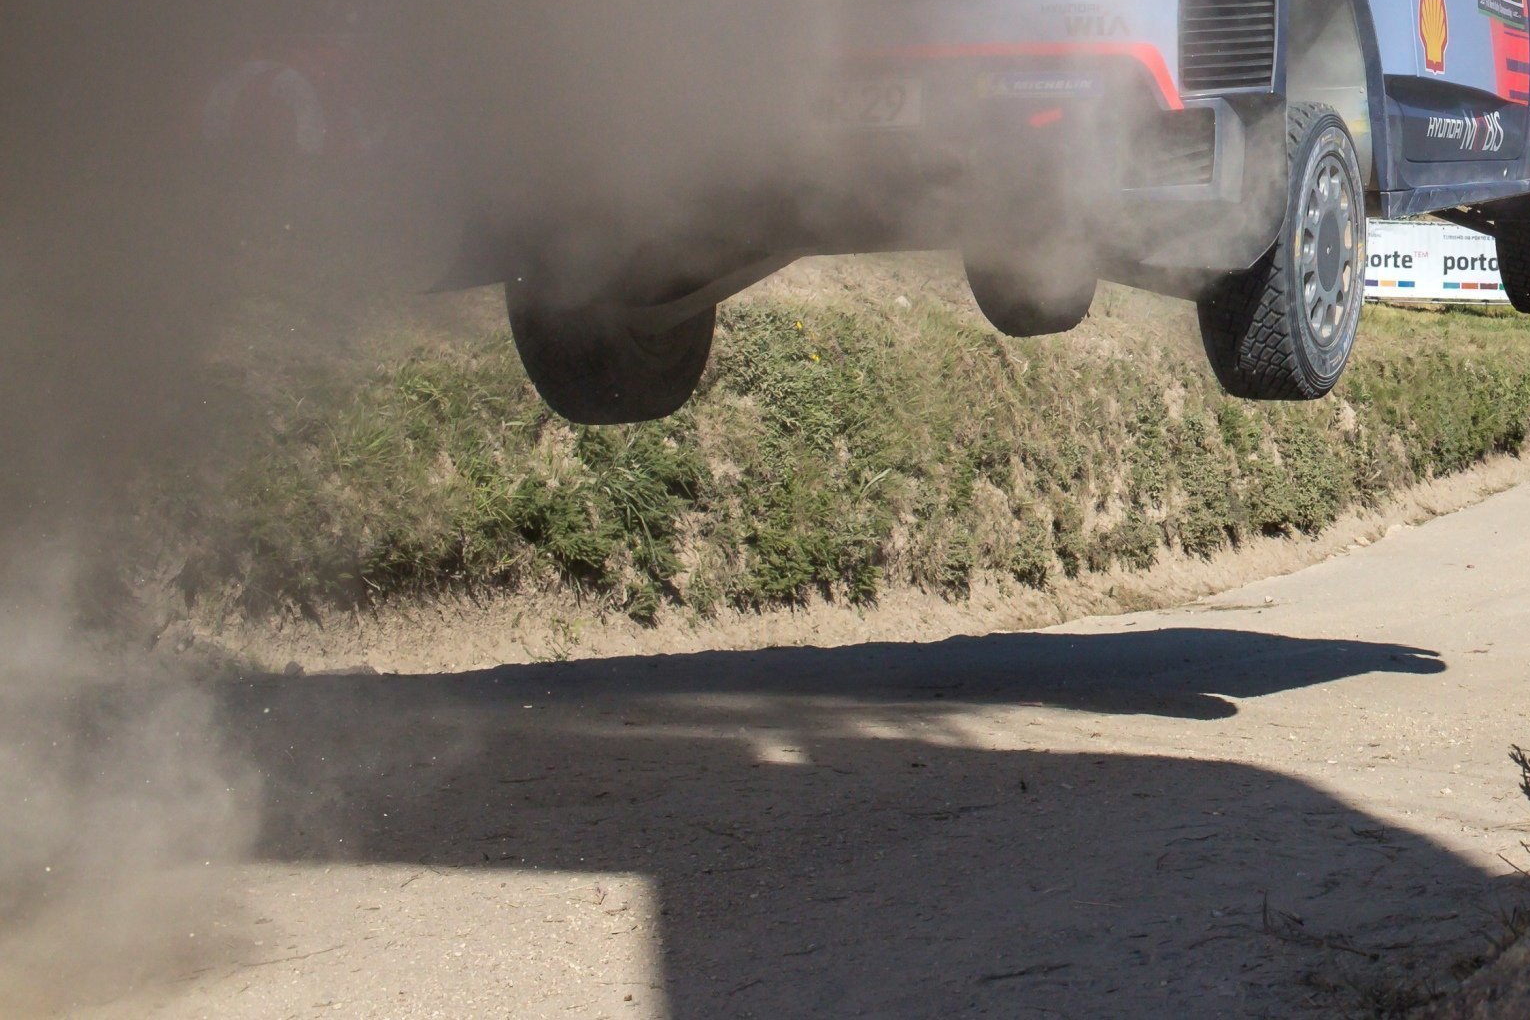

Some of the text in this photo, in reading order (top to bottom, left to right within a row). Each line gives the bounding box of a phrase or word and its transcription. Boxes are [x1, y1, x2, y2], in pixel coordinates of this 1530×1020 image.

[1426, 117, 1464, 139] HYUNDAI
[1365, 251, 1413, 269] orte
[1443, 253, 1498, 275] porto
